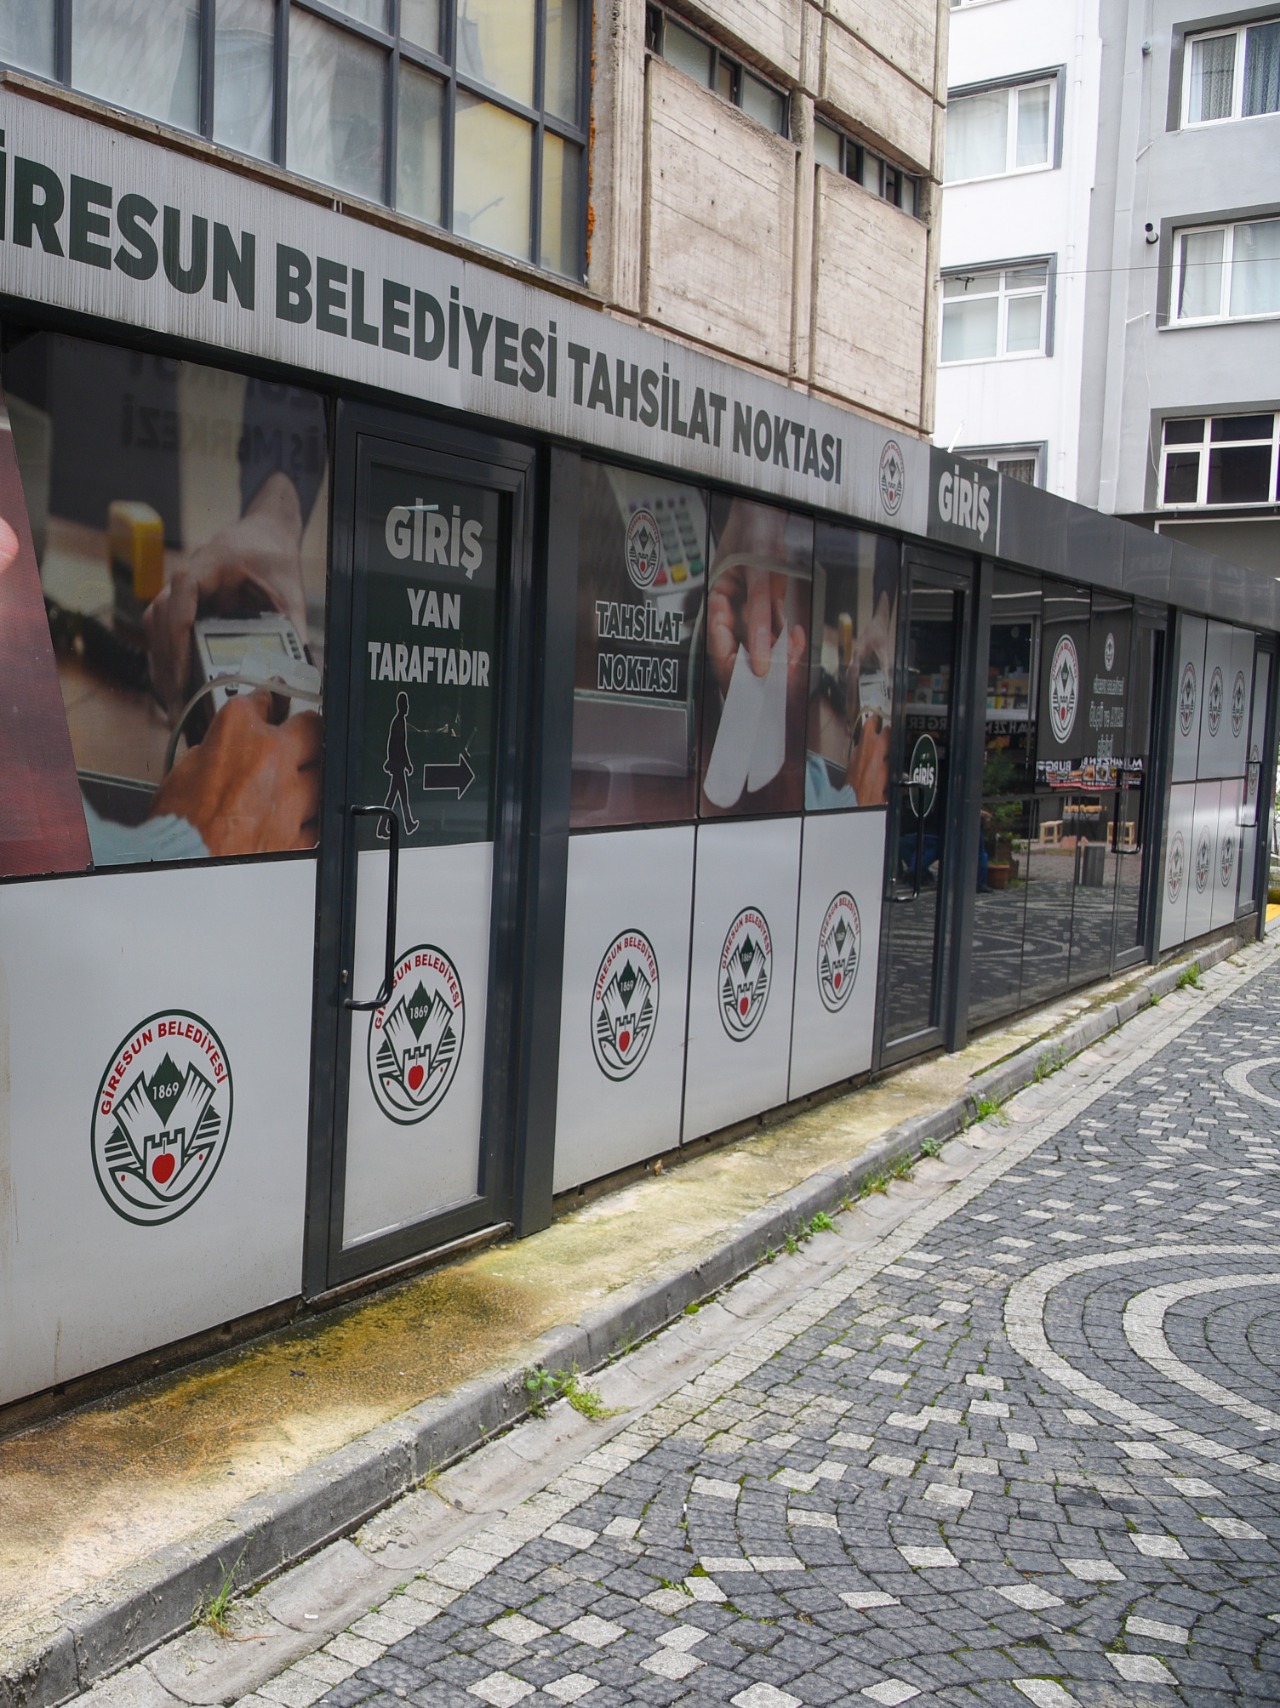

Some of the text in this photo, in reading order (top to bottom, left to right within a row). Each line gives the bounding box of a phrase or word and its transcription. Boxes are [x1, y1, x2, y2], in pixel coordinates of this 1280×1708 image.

[276, 242, 558, 398] BELEDİYESİ
[567, 341, 727, 449] TAHSİLAT
[732, 400, 842, 486] NOKTASI
[938, 464, 990, 543] GİRİŞ
[384, 498, 484, 580] GİRİŞ
[406, 587, 461, 630] YAN
[595, 600, 684, 645] TAHSİLAT
[367, 641, 490, 687] TARAFTADIR
[597, 653, 679, 693] NOKTASI
[913, 763, 935, 789] GİRİŞ
[596, 937, 658, 1001] GİRESUN BELEDİYESİ
[620, 980, 634, 993] 1869
[375, 954, 463, 1030] GİSUN BELEDİYESİ
[410, 1005, 429, 1020] 1869
[101, 1020, 228, 1115] GİRESUN BELEDİYESİ
[152, 1081, 180, 1100] 1869
